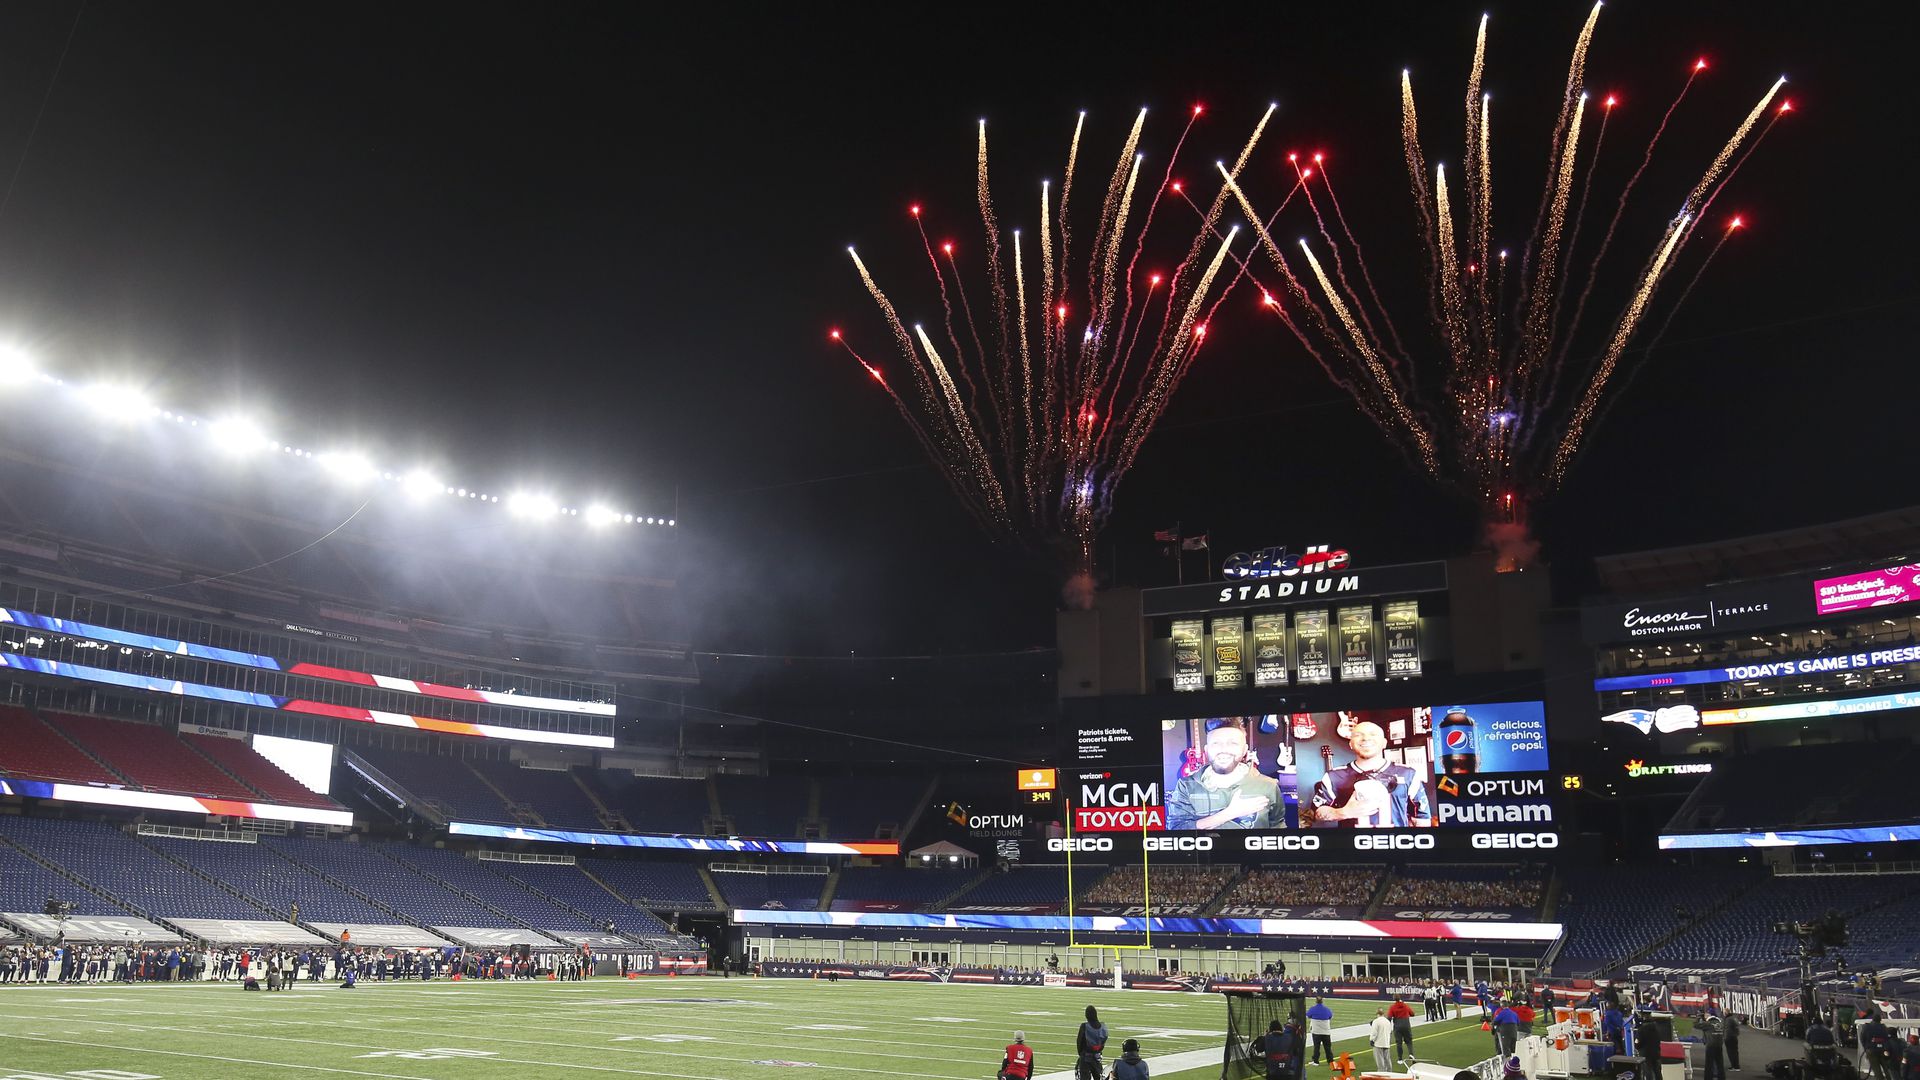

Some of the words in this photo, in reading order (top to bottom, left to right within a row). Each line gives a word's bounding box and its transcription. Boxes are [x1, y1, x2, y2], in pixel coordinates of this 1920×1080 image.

[1222, 544, 1351, 582] Gillette
[1219, 576, 1360, 602] STADIUM
[1820, 586, 1837, 597] $10
[1837, 578, 1885, 593] blackjack
[1821, 590, 1876, 606] minimums
[1876, 585, 1905, 597] daily.
[1718, 603, 1769, 616] TERRACE
[1624, 608, 1708, 628] Encore
[1631, 627, 1665, 636] BOSTON
[1667, 623, 1702, 633] HARBOR
[1301, 669, 1327, 677] 2014
[1345, 665, 1371, 674] 2016
[1390, 662, 1416, 670] 2018
[1725, 662, 1795, 681] TODAY'S
[1798, 656, 1848, 673] GAME
[1851, 653, 1868, 667] IS
[1177, 677, 1201, 685] 2001
[1217, 674, 1242, 682] 2003
[1257, 671, 1285, 680] 2004
[1840, 700, 1891, 714] ABIOMED
[1491, 719, 1543, 730] delicious.
[1484, 730, 1544, 742] refreshing.
[1511, 741, 1545, 752] pepsi.
[1079, 772, 1103, 780] verizon
[1564, 776, 1581, 789] 25
[1082, 782, 1157, 807] MGM
[1467, 779, 1544, 796] OPTUM
[1032, 792, 1051, 802] 3:49
[1078, 811, 1163, 828] TOYOTA
[1438, 803, 1552, 823] Putnam
[969, 814, 1024, 829] OPTUM
[991, 829, 1023, 837] LOUNGE
[1047, 838, 1114, 852] GEICO
[1143, 836, 1213, 851] GEICO
[1244, 835, 1320, 850] GEICO
[1354, 834, 1435, 850] GEICO
[1471, 832, 1559, 849] GEICO
